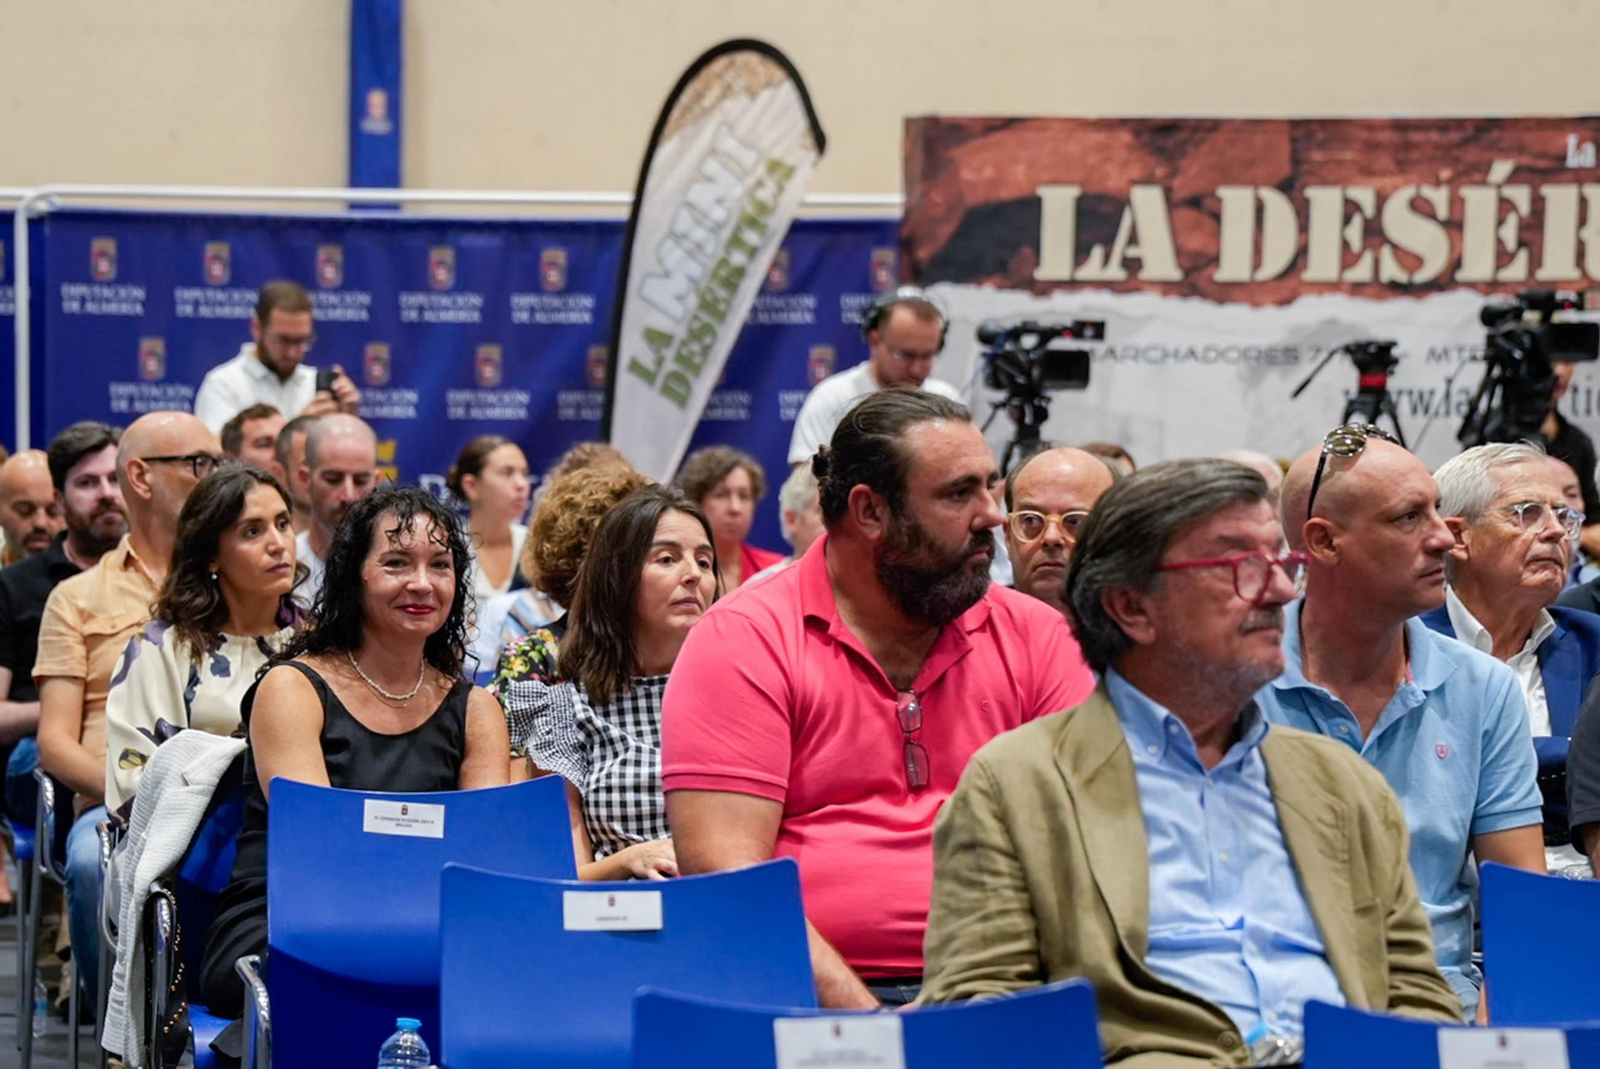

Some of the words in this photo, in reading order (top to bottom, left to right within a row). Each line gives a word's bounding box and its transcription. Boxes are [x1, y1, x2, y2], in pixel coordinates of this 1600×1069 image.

[639, 123, 759, 325] MINI
[1033, 184, 1184, 282] LA
[627, 326, 674, 386] LA
[1088, 342, 1300, 366] ARCHADORES
